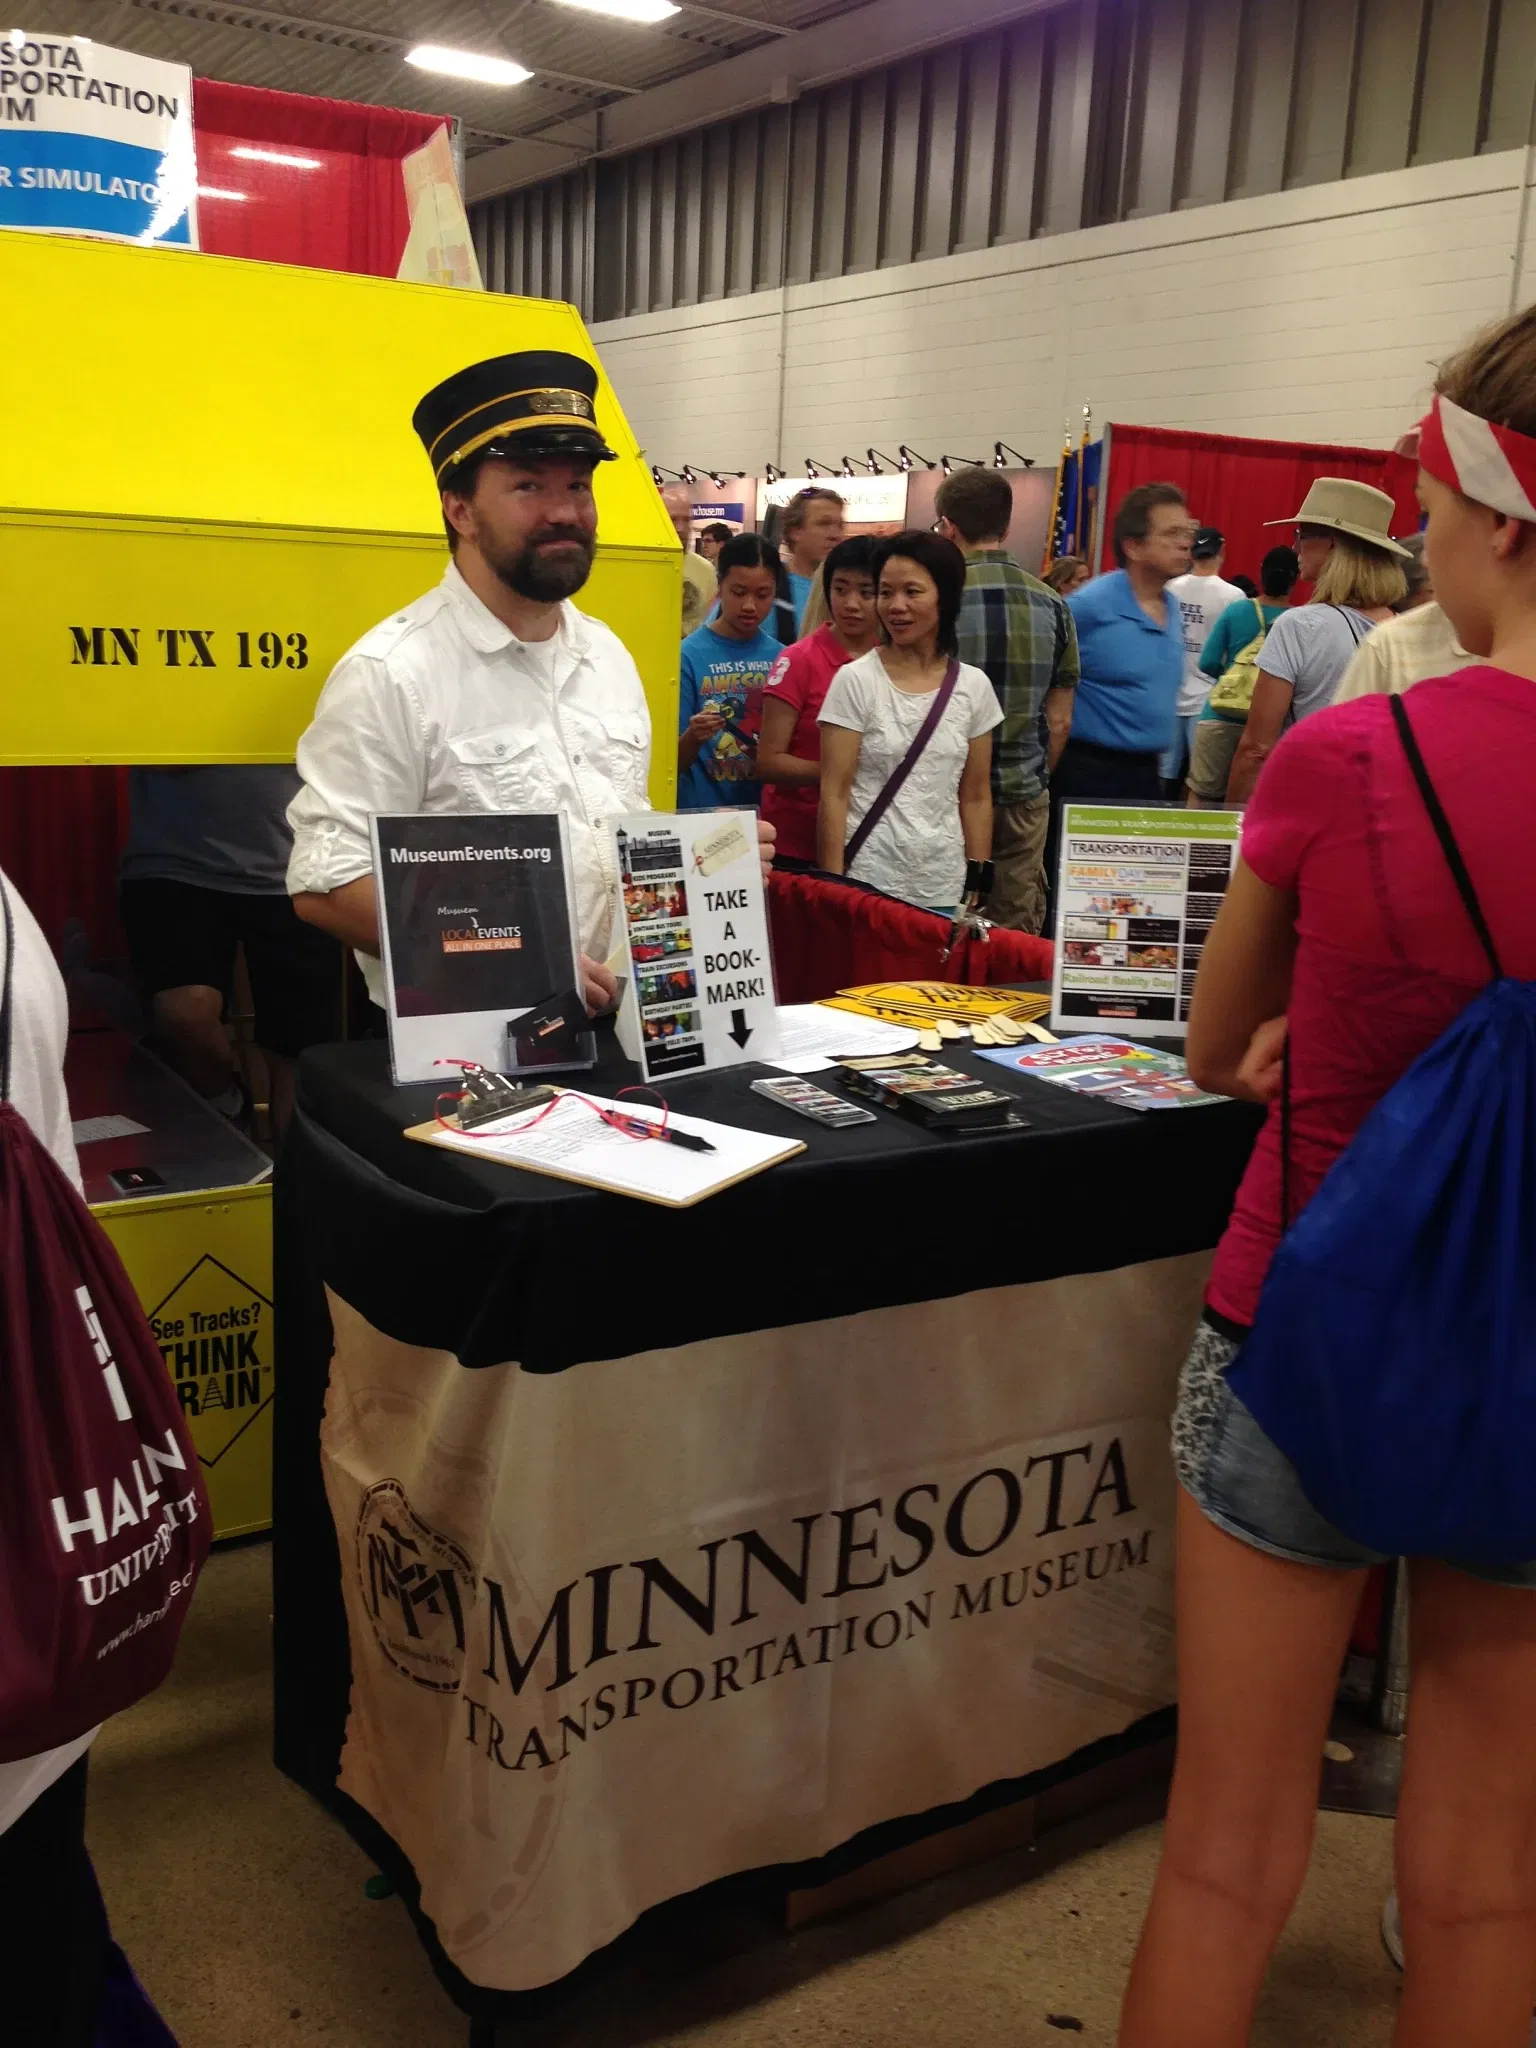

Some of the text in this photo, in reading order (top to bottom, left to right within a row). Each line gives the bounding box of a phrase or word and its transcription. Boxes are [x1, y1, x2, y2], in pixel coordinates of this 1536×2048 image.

[0, 69, 179, 120] PORTATION
[0, 98, 36, 122] M
[20, 166, 161, 205] SIMULATO
[68, 626, 309, 670] MN TX 193
[708, 661, 733, 673] THIS
[734, 660, 745, 672] IS
[767, 656, 791, 686] 3
[701, 671, 767, 695] AWESO
[647, 829, 672, 837] MUSEUM
[390, 846, 551, 864] MuseumEvents.org
[1071, 842, 1184, 857] TRANSPORTATION
[646, 872, 677, 881] PROGRAMS
[1071, 867, 1117, 878] FAMILY
[703, 889, 749, 912] TAKE
[633, 921, 682, 933] VINTAGE BUS TOURS
[723, 921, 736, 941] A
[445, 939, 521, 952] ALL IN ONE PLACE
[656, 960, 688, 971] EXCURSIONS
[704, 948, 761, 974] BOOK-
[706, 977, 766, 1005] MARK!
[644, 1006, 671, 1016] BIRTHDAY
[151, 1302, 261, 1340] See Tracks?
[177, 1369, 261, 1416] RAIN
[482, 1437, 1137, 1696] MINNESOTA
[463, 1529, 1157, 1771] TRANSPORTATION MUSEUM
